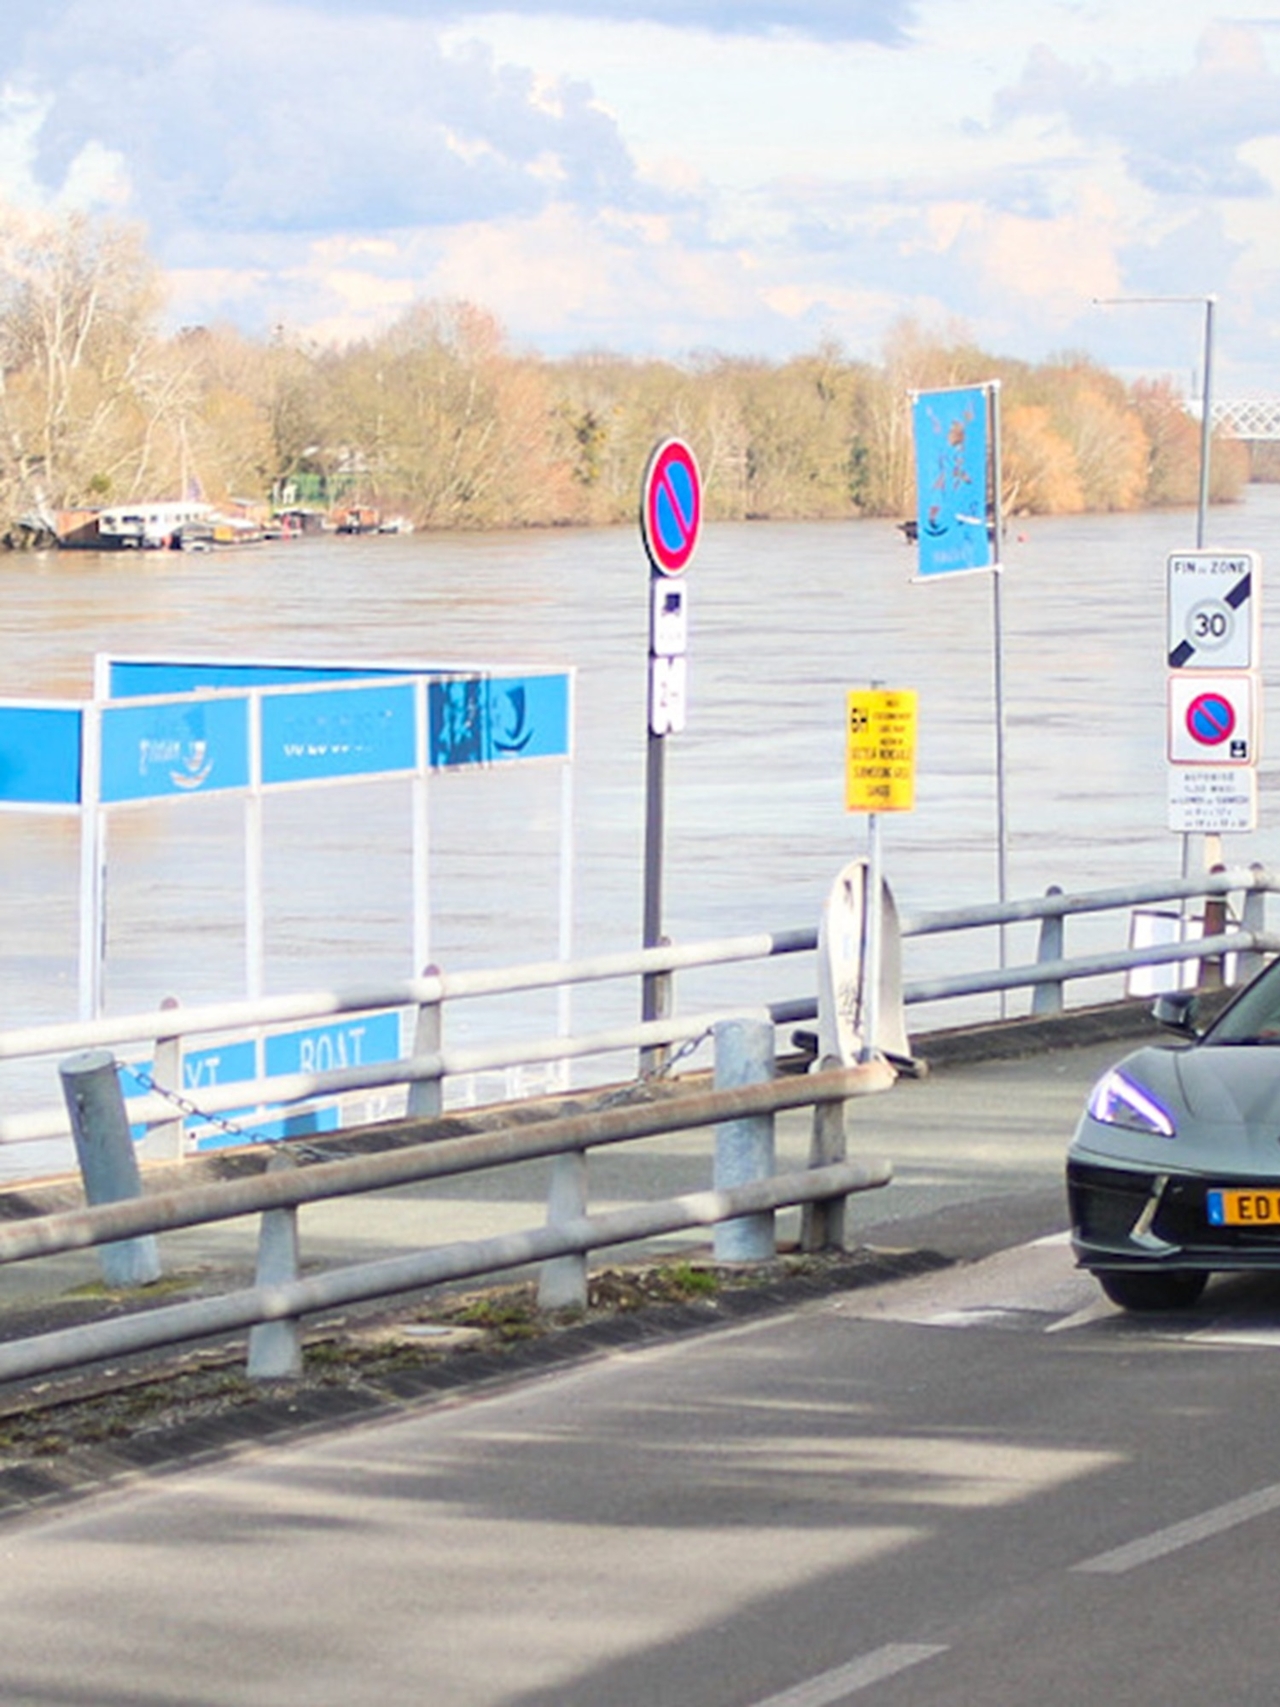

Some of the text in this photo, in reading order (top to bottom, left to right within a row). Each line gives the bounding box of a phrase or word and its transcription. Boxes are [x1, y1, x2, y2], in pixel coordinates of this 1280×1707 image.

[1174, 561, 1196, 573] FIN
[1210, 561, 1246, 574] ZONE
[1195, 613, 1227, 637] 30
[1238, 1195, 1271, 1220] ED
